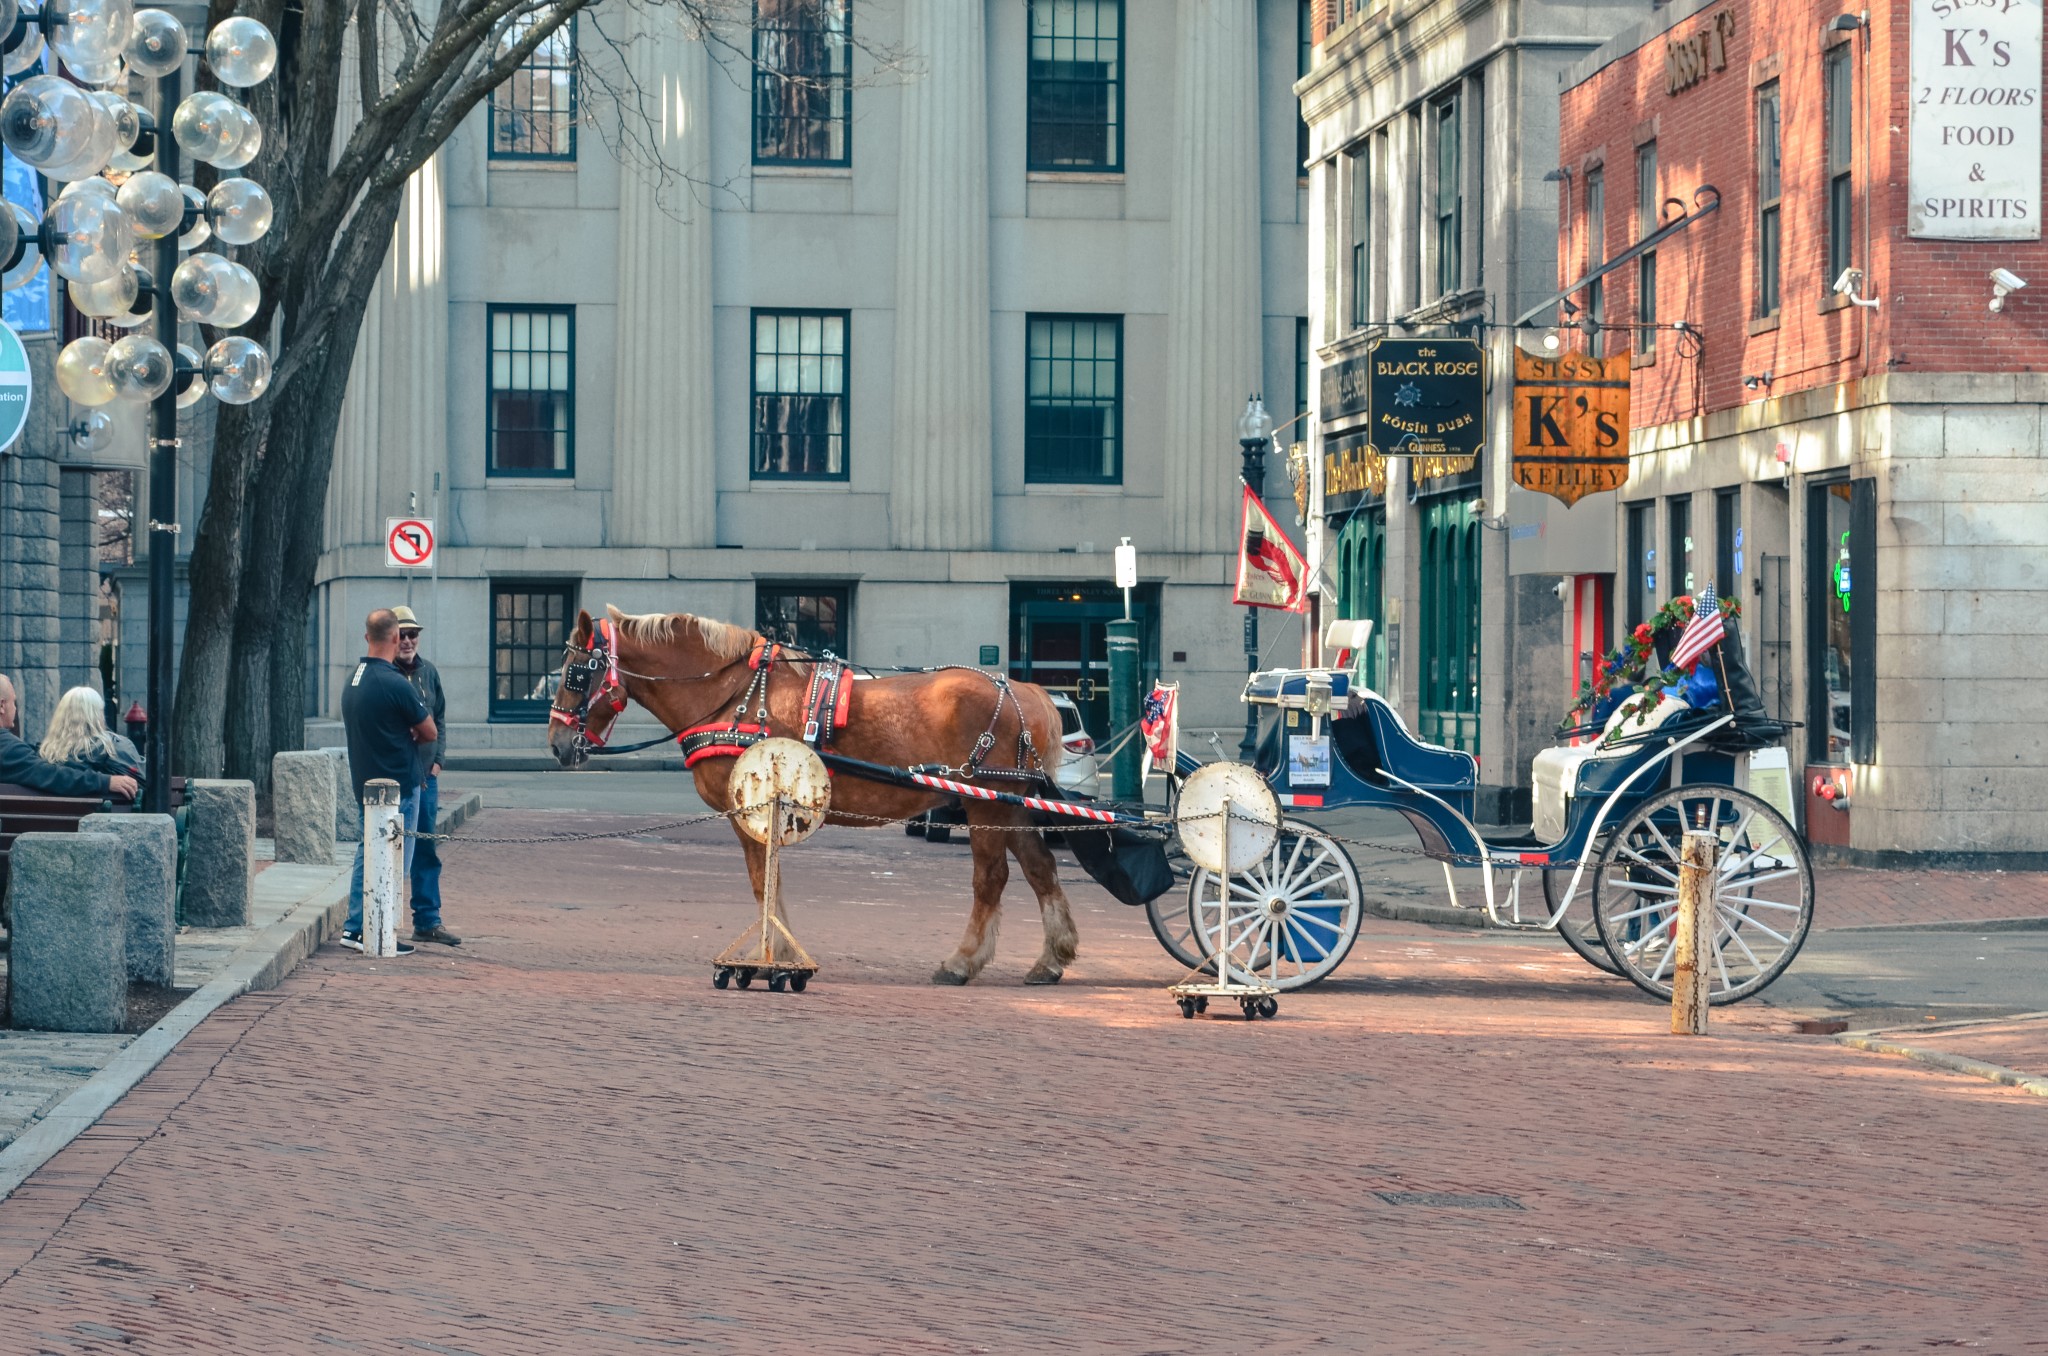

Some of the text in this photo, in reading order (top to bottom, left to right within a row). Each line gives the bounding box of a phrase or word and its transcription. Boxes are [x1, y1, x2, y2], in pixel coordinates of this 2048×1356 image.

[1918, 87, 2036, 106] 2 FLOORS
[1942, 125, 2014, 146] FOOD
[1968, 162, 1986, 182] &
[1924, 197, 2027, 219] SPIRITS
[1417, 347, 1437, 357] the
[1377, 361, 1478, 376] BLACK ROSE
[1533, 360, 1609, 379] SISSY
[1437, 413, 1473, 433] DUBH
[1525, 394, 1620, 448] K's
[1520, 468, 1622, 486] KELLEY
